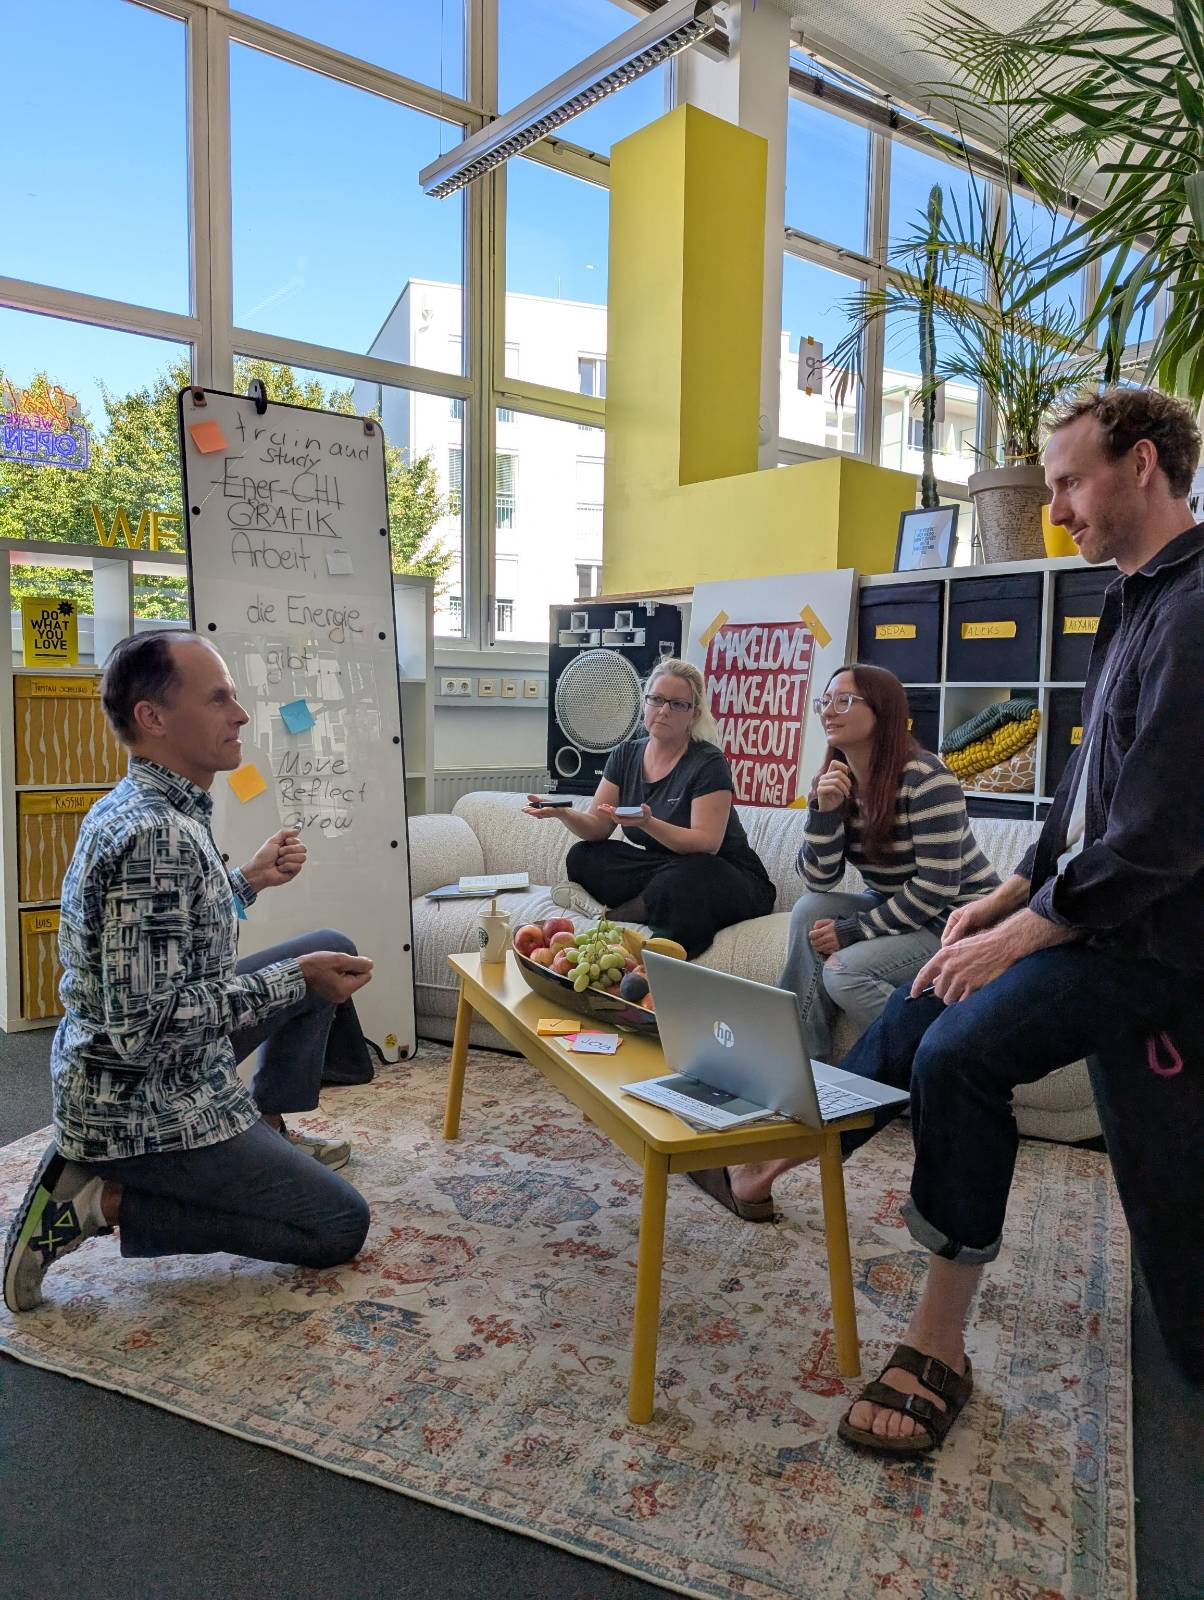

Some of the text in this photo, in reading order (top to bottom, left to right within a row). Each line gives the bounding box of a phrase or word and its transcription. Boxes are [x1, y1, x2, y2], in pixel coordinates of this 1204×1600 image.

[235, 411, 321, 450] train
[227, 500, 338, 537] GRAFIK
[41, 609, 59, 620] DO
[246, 592, 363, 644] die Energie
[31, 619, 70, 631] WHAT
[37, 629, 63, 640] YOU
[34, 638, 68, 650] LOVE
[278, 750, 351, 776] Move
[35, 916, 53, 929] LUIS
[713, 1020, 734, 1048] hp
